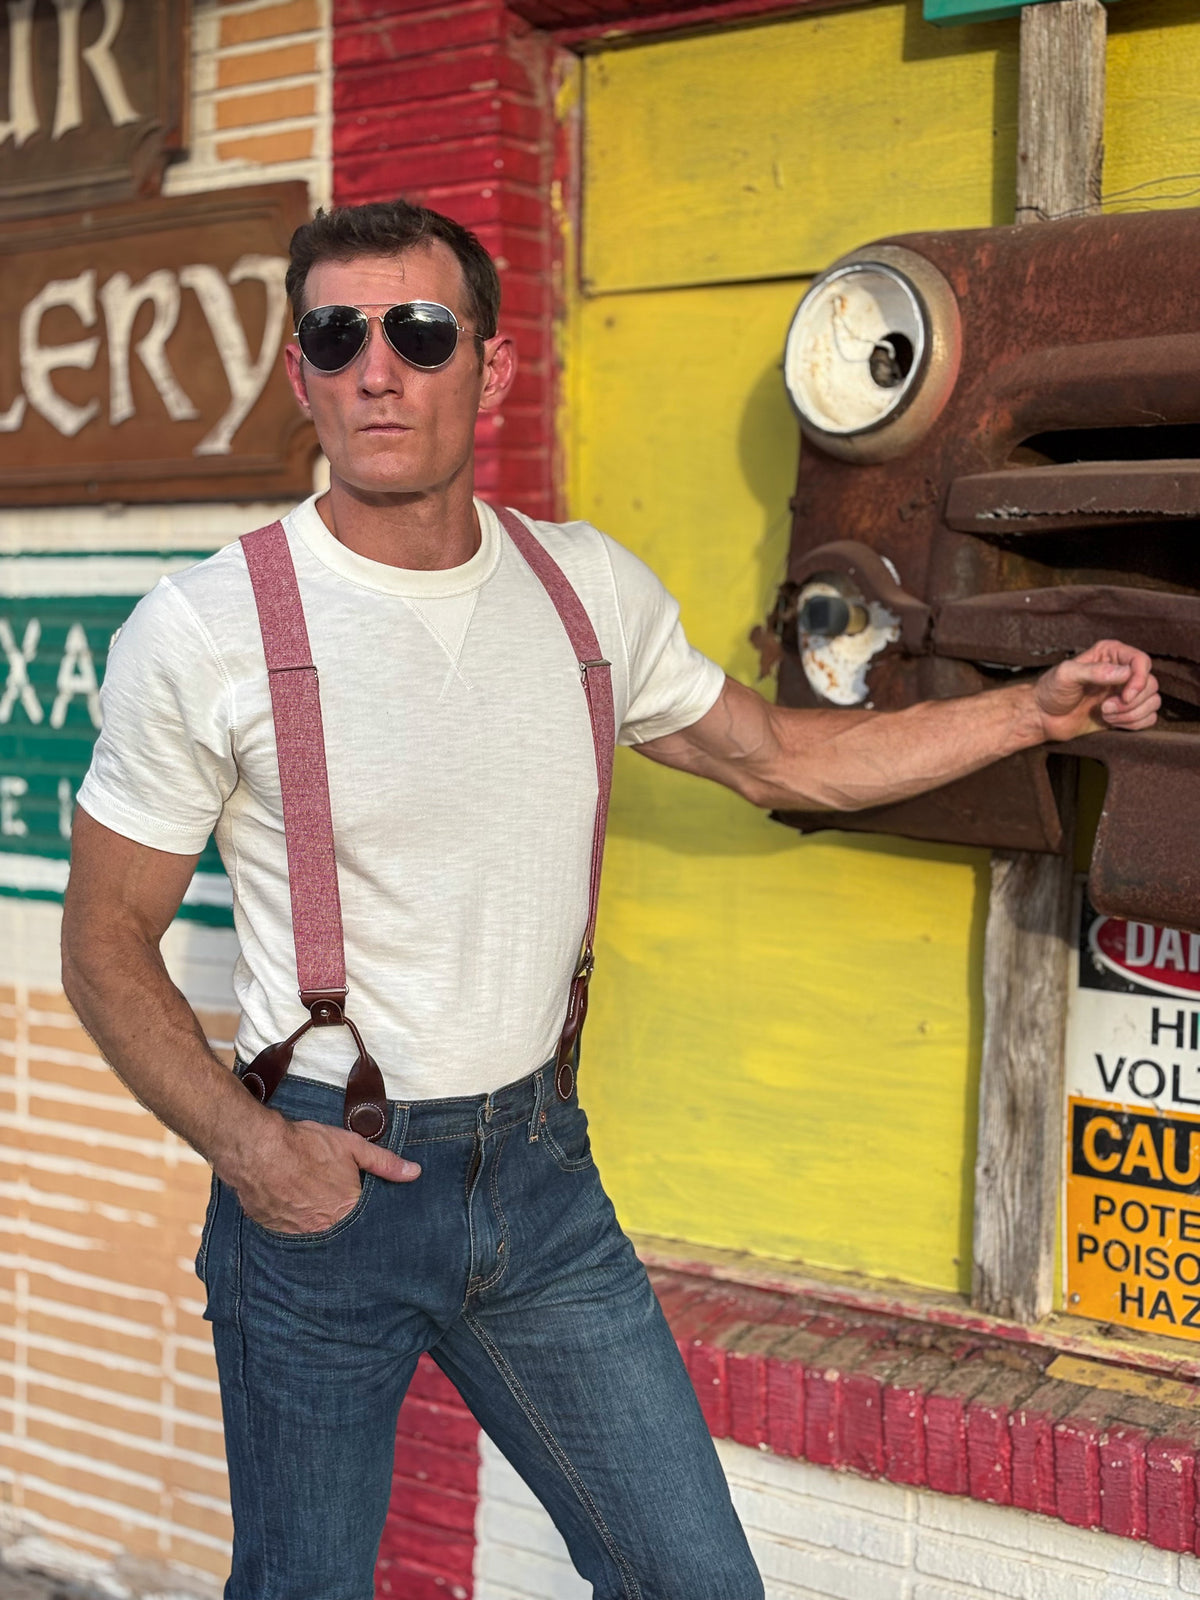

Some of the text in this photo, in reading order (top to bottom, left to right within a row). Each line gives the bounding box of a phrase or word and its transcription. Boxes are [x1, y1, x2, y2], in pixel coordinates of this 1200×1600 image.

[0, 254, 289, 456] ERY
[0, 616, 121, 730] XA
[1151, 1006, 1199, 1050] HI
[1094, 1053, 1200, 1105] VOL
[1083, 1115, 1200, 1186] CAU
[1094, 1194, 1200, 1243] POTE
[1077, 1233, 1200, 1287] POISO
[1120, 1282, 1200, 1329] HAZ
